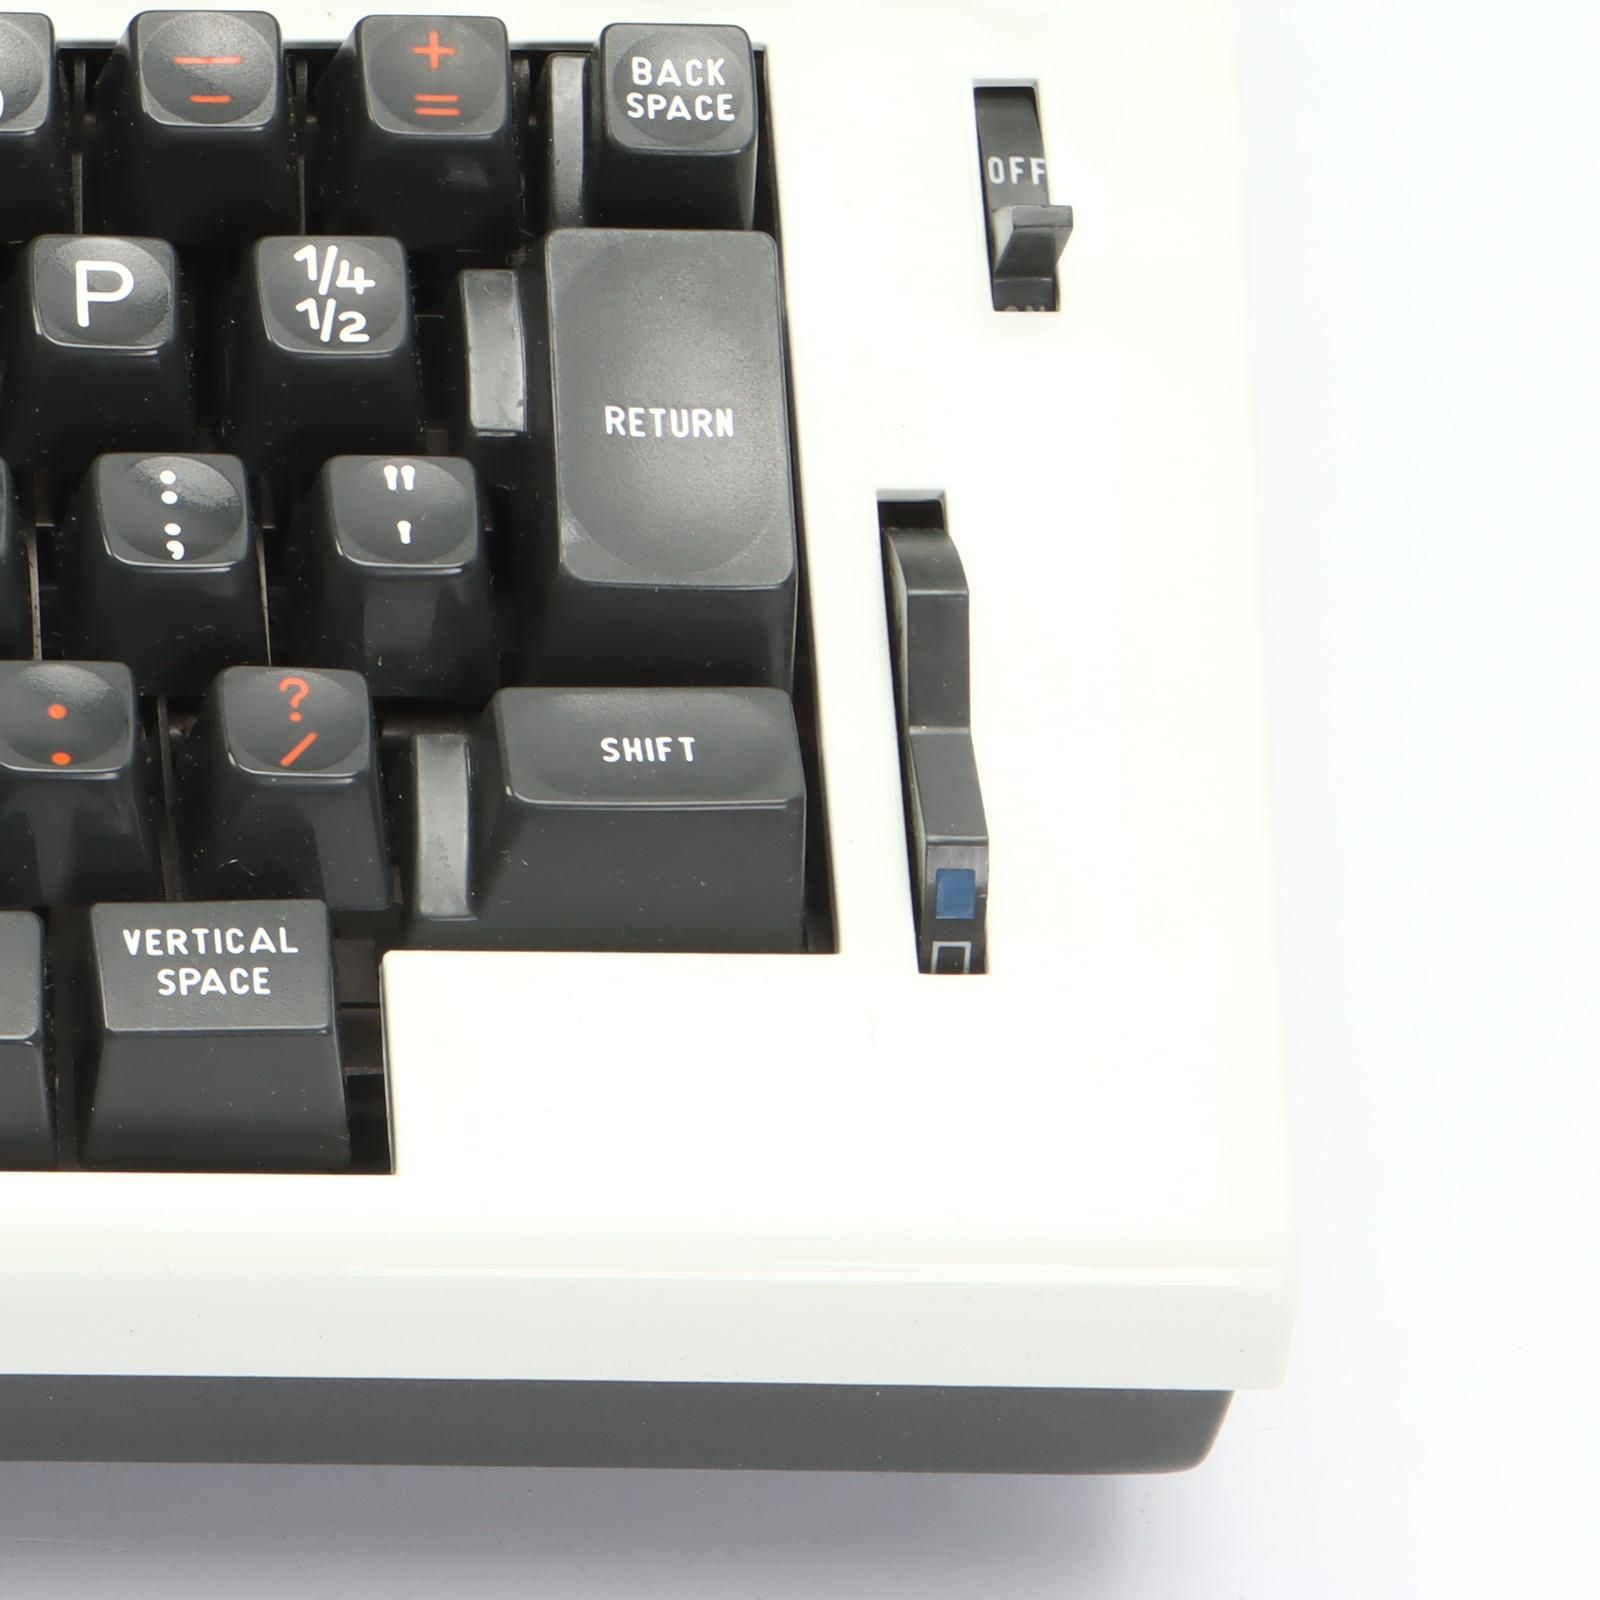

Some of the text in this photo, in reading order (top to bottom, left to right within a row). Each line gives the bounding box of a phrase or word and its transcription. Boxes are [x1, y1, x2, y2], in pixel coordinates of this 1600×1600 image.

[412, 30, 457, 70] +
[632, 56, 725, 87] BACK
[415, 93, 461, 117] =
[626, 92, 735, 121] SPACE
[987, 156, 1047, 185] OFF
[75, 260, 134, 327] P
[605, 405, 734, 438] RETURN
[278, 677, 310, 723] ?
[280, 732, 317, 767] /
[601, 736, 695, 762] SHIFT
[123, 927, 299, 956] VERTICAL
[157, 967, 271, 996] SPACE
